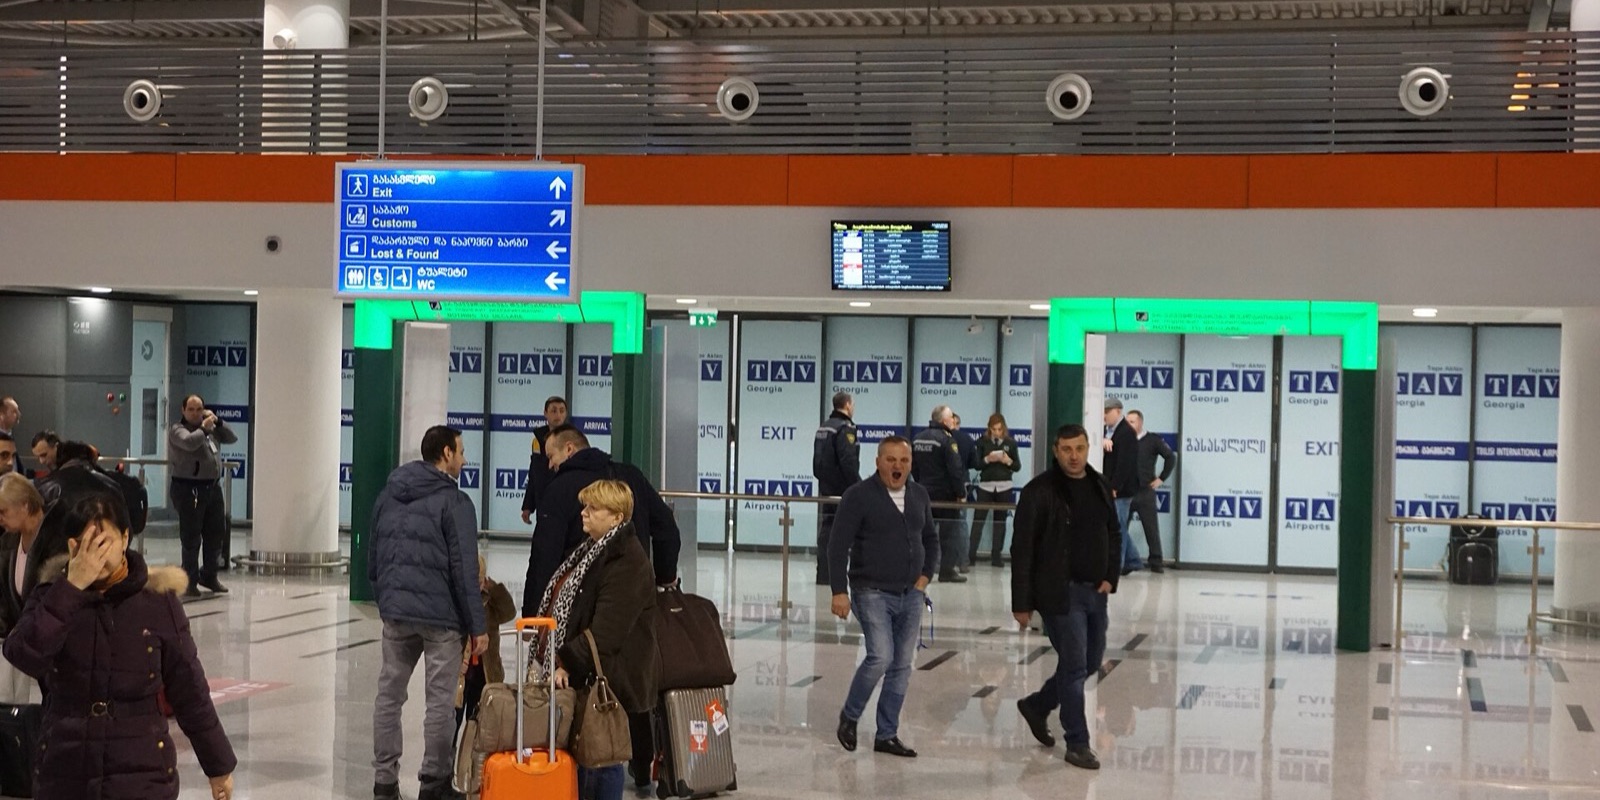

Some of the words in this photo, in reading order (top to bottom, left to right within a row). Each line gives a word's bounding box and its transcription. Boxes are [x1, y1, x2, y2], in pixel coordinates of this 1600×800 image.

[372, 187, 393, 198] Exit
[373, 205, 409, 215] საბაჟო
[372, 218, 418, 229] Customs
[434, 236, 447, 246] და
[497, 237, 529, 248] ბარგი
[371, 249, 394, 259] Lost
[396, 249, 404, 259] &
[406, 249, 439, 260] Found
[417, 279, 436, 291] WC
[190, 348, 244, 365] TAV
[501, 356, 559, 373] TAV
[187, 368, 218, 378] Georgia
[750, 362, 812, 381] TAV
[836, 363, 899, 381] TAV
[925, 365, 988, 383] TAV
[497, 376, 532, 386] Georgia
[1105, 368, 1170, 387] TAV
[1194, 372, 1262, 390] TAV
[1293, 373, 1335, 392] TA
[577, 378, 613, 389] Georgia
[746, 384, 783, 394] Georgia
[1488, 377, 1560, 397] TAV
[832, 385, 869, 395] Georgia
[920, 387, 957, 396] Georgia
[1009, 389, 1033, 397] Geor
[1190, 394, 1230, 404] Georgia
[1288, 396, 1329, 406] Georgia
[1483, 400, 1526, 411] Georgia
[583, 420, 608, 431] ARRIVAL
[761, 425, 797, 441] EXIT
[1186, 438, 1267, 454] გასასვლელი
[1496, 447, 1541, 458] INTERNATIONAL
[496, 490, 525, 499] Airpor
[748, 482, 810, 497] TAV
[744, 501, 785, 511] Airports
[1191, 497, 1259, 517] TAV
[1288, 500, 1333, 519] TA
[1485, 505, 1557, 522] TAV
[1187, 518, 1232, 529] Airports
[1284, 521, 1330, 532] Airports
[1497, 527, 1528, 537] ports
